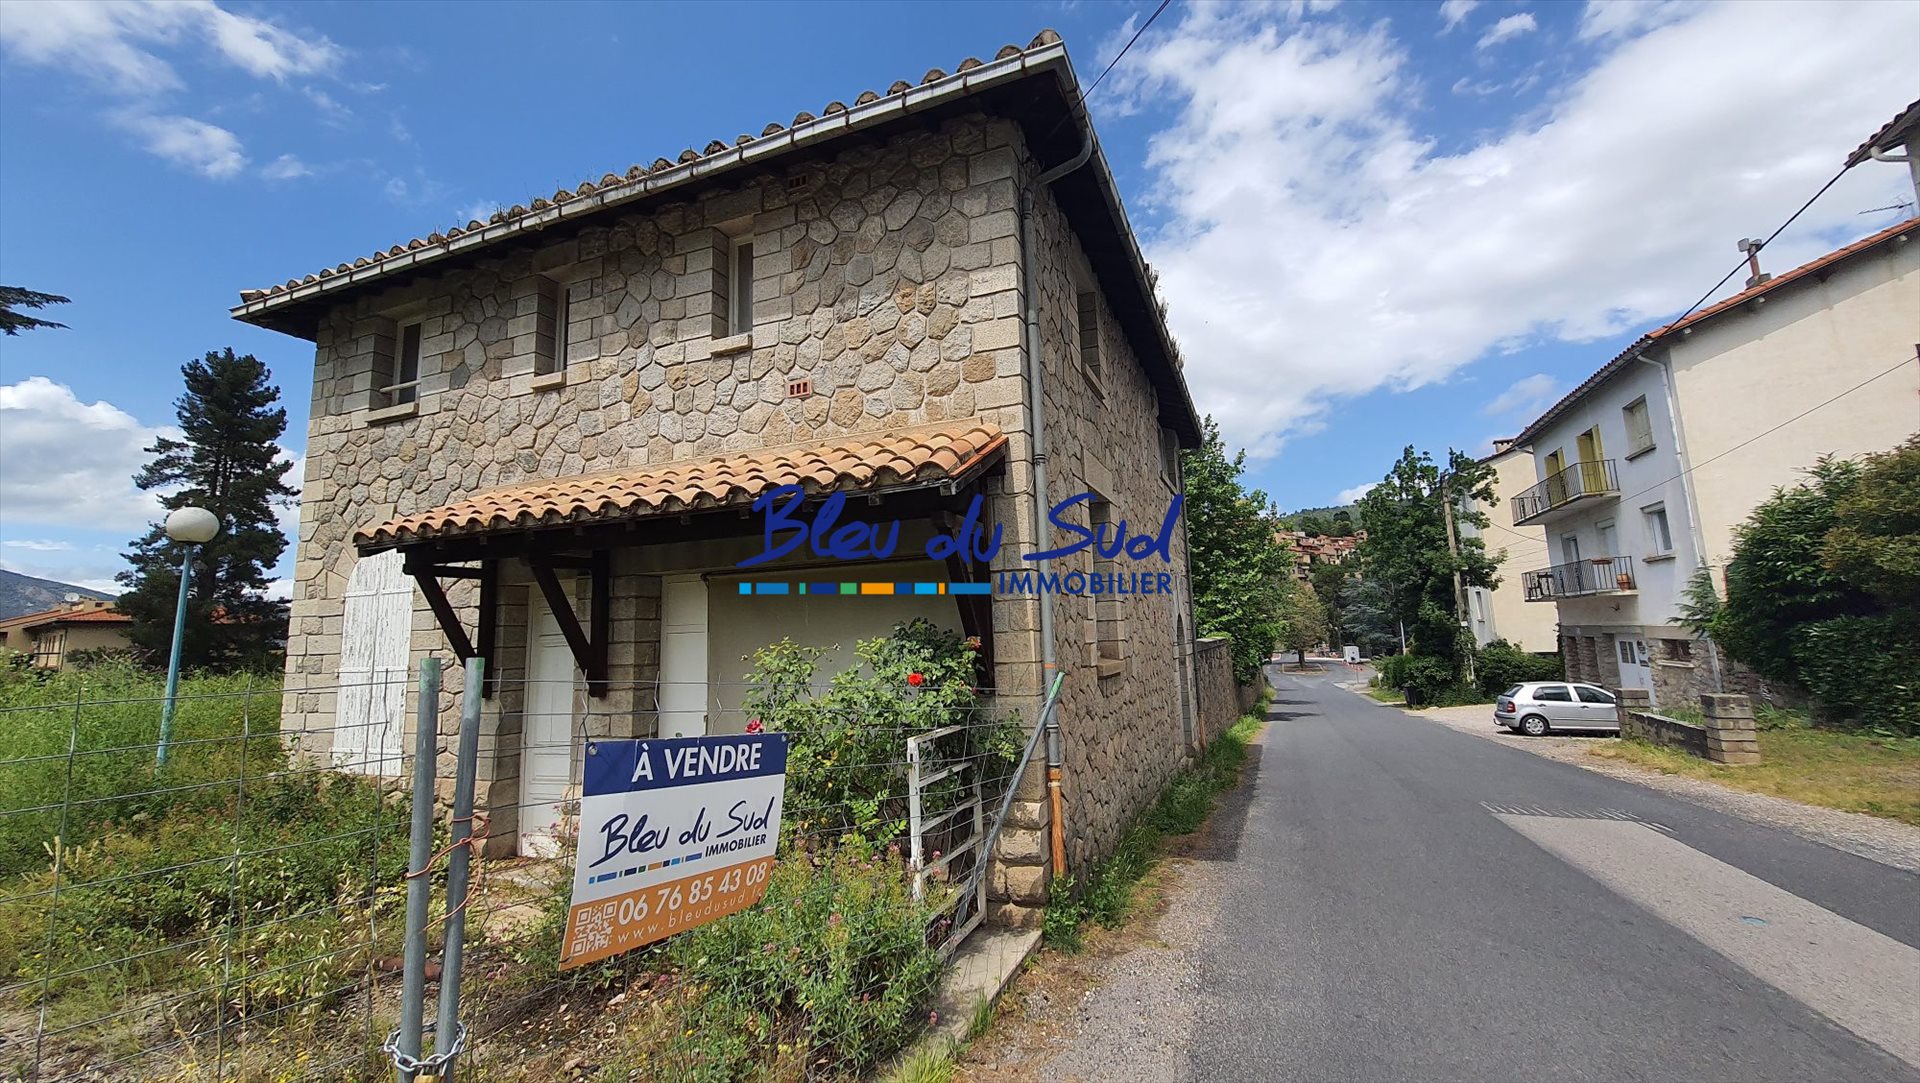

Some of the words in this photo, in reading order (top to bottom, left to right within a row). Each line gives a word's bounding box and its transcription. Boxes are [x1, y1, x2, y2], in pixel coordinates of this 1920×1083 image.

[631, 743, 654, 783] À
[664, 743, 762, 779] VENDRE
[589, 814, 669, 868] Bleu
[679, 807, 711, 845] du
[716, 796, 775, 838] Sud
[705, 834, 766, 857] IMMOBILIER
[618, 894, 648, 926] 06
[655, 884, 682, 915] 76
[688, 876, 713, 905] 85
[718, 868, 741, 893] 43
[746, 861, 768, 886] 08
